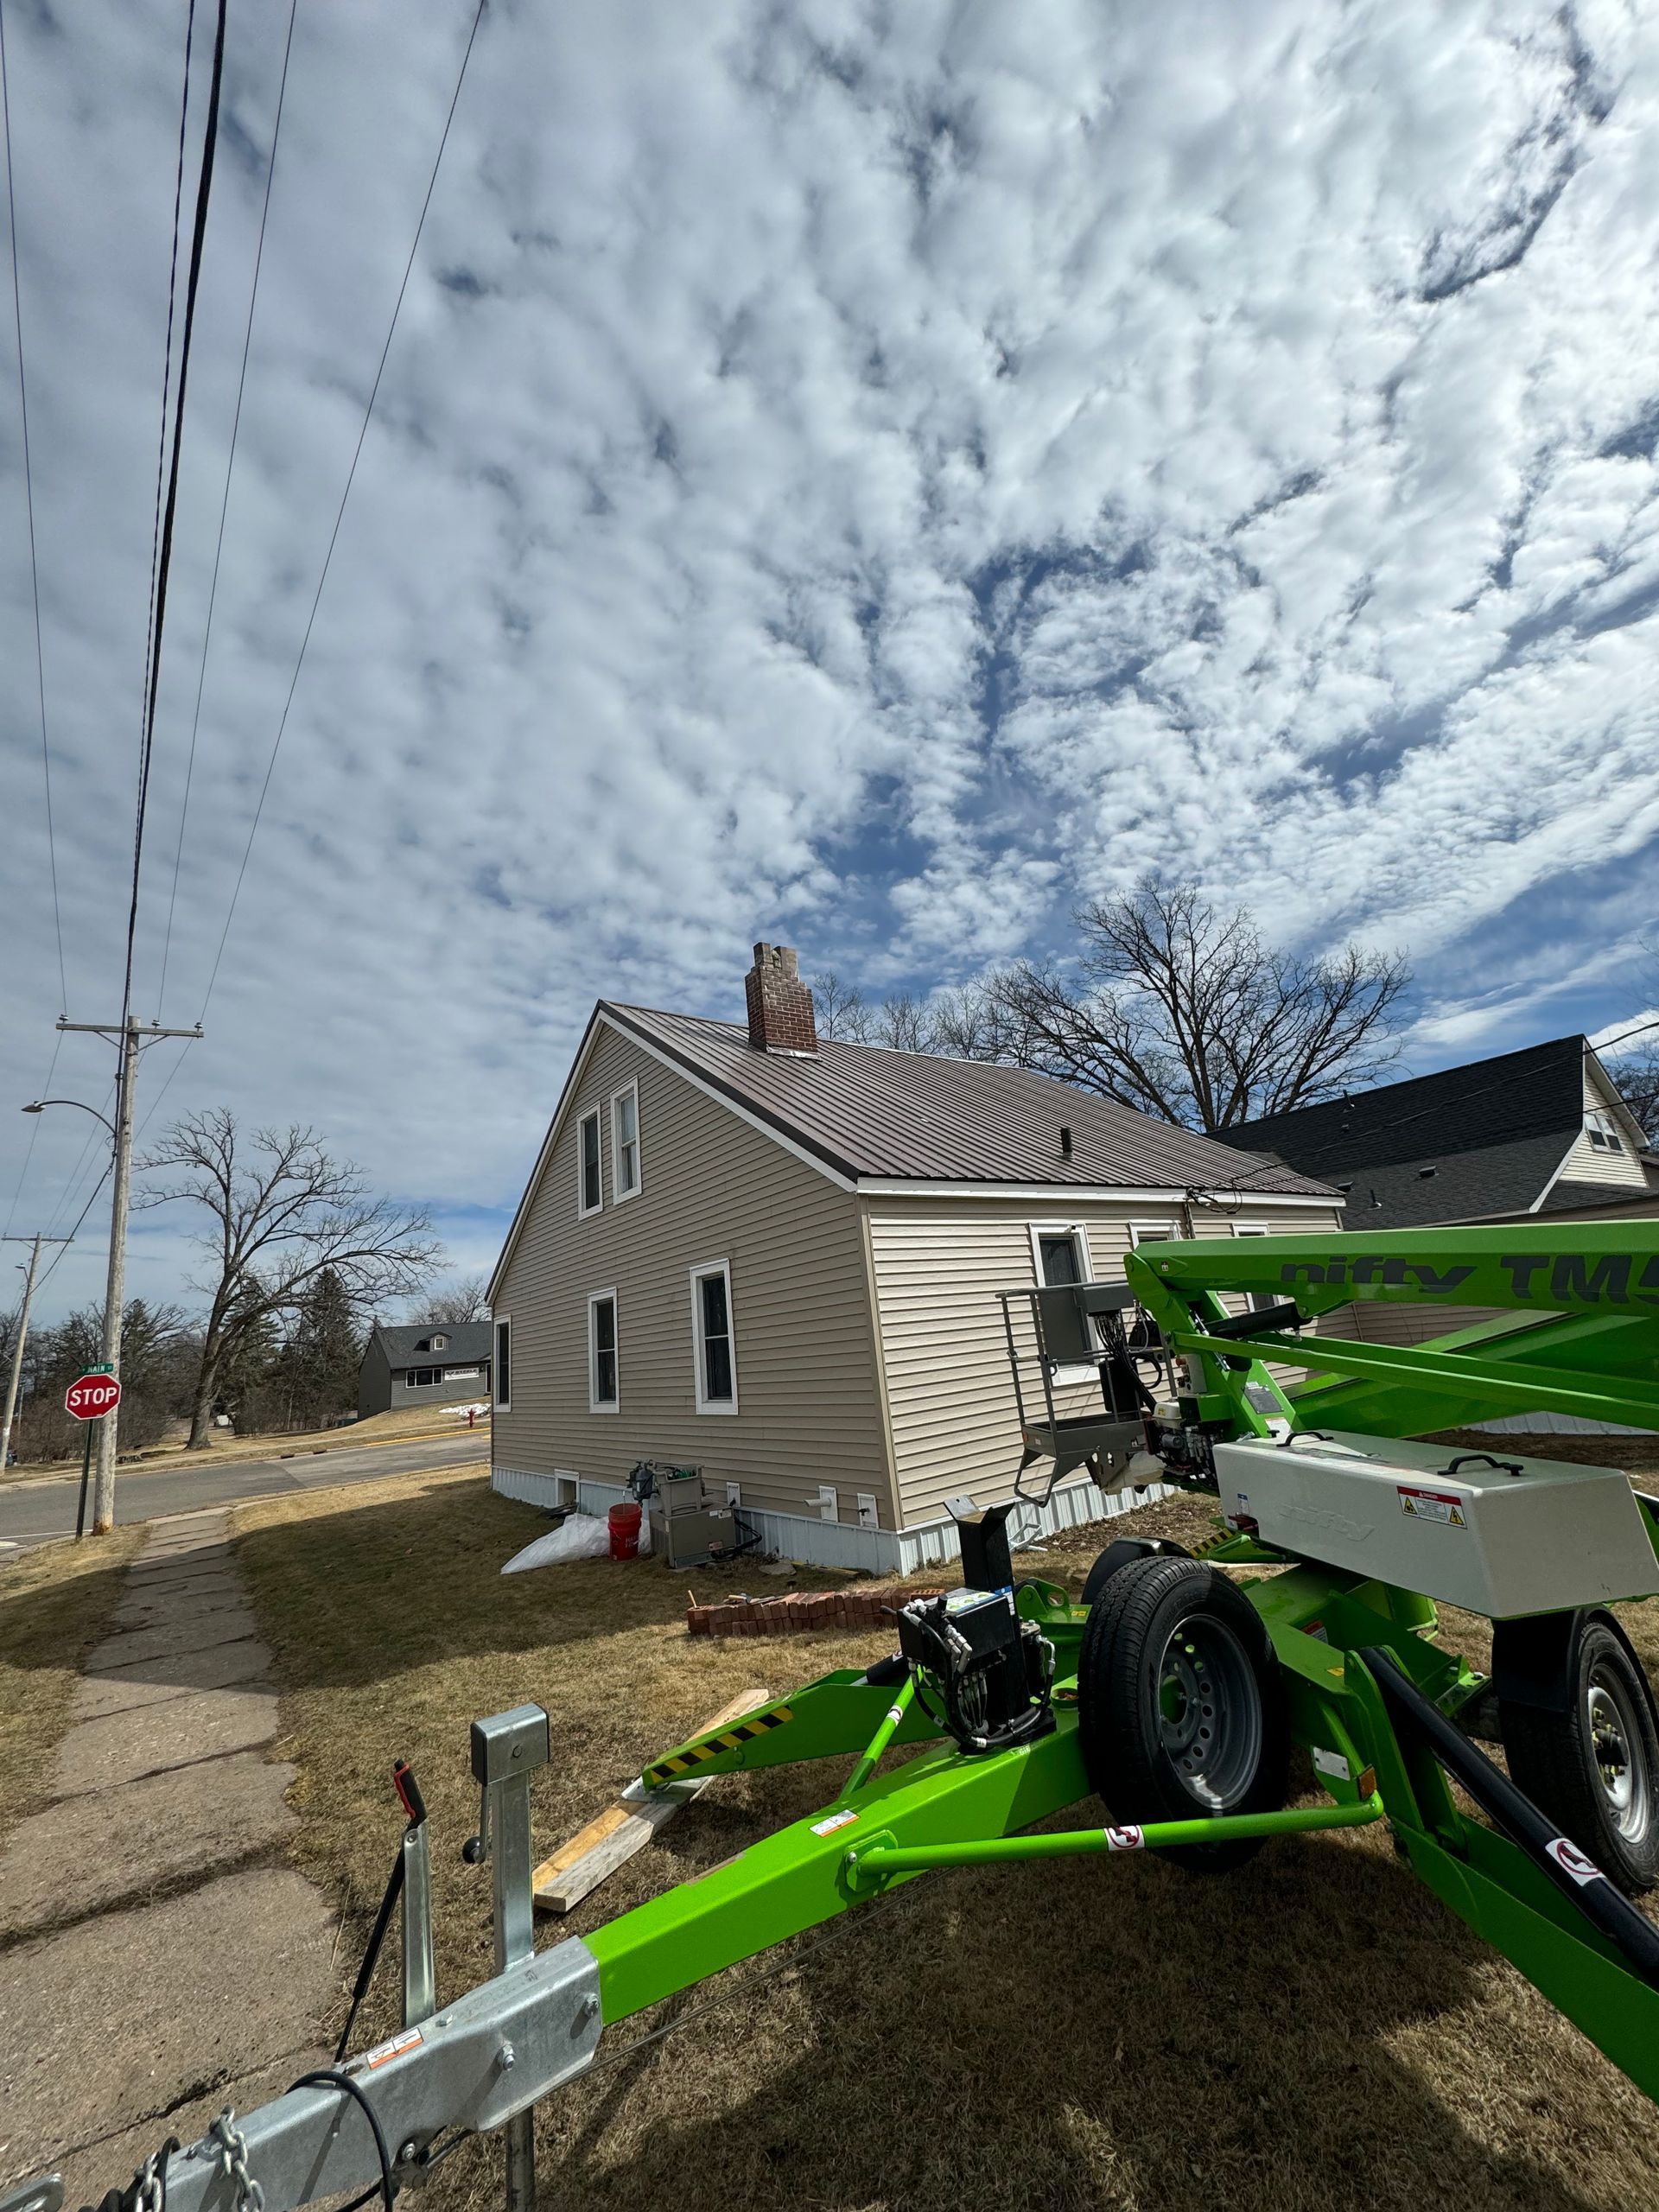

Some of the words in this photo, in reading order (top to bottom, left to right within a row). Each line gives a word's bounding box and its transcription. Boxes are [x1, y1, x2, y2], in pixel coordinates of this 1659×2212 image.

[1281, 1255, 1478, 1294] nifty
[88, 1365, 105, 1374] MAIN
[70, 1387, 118, 1407] STOP
